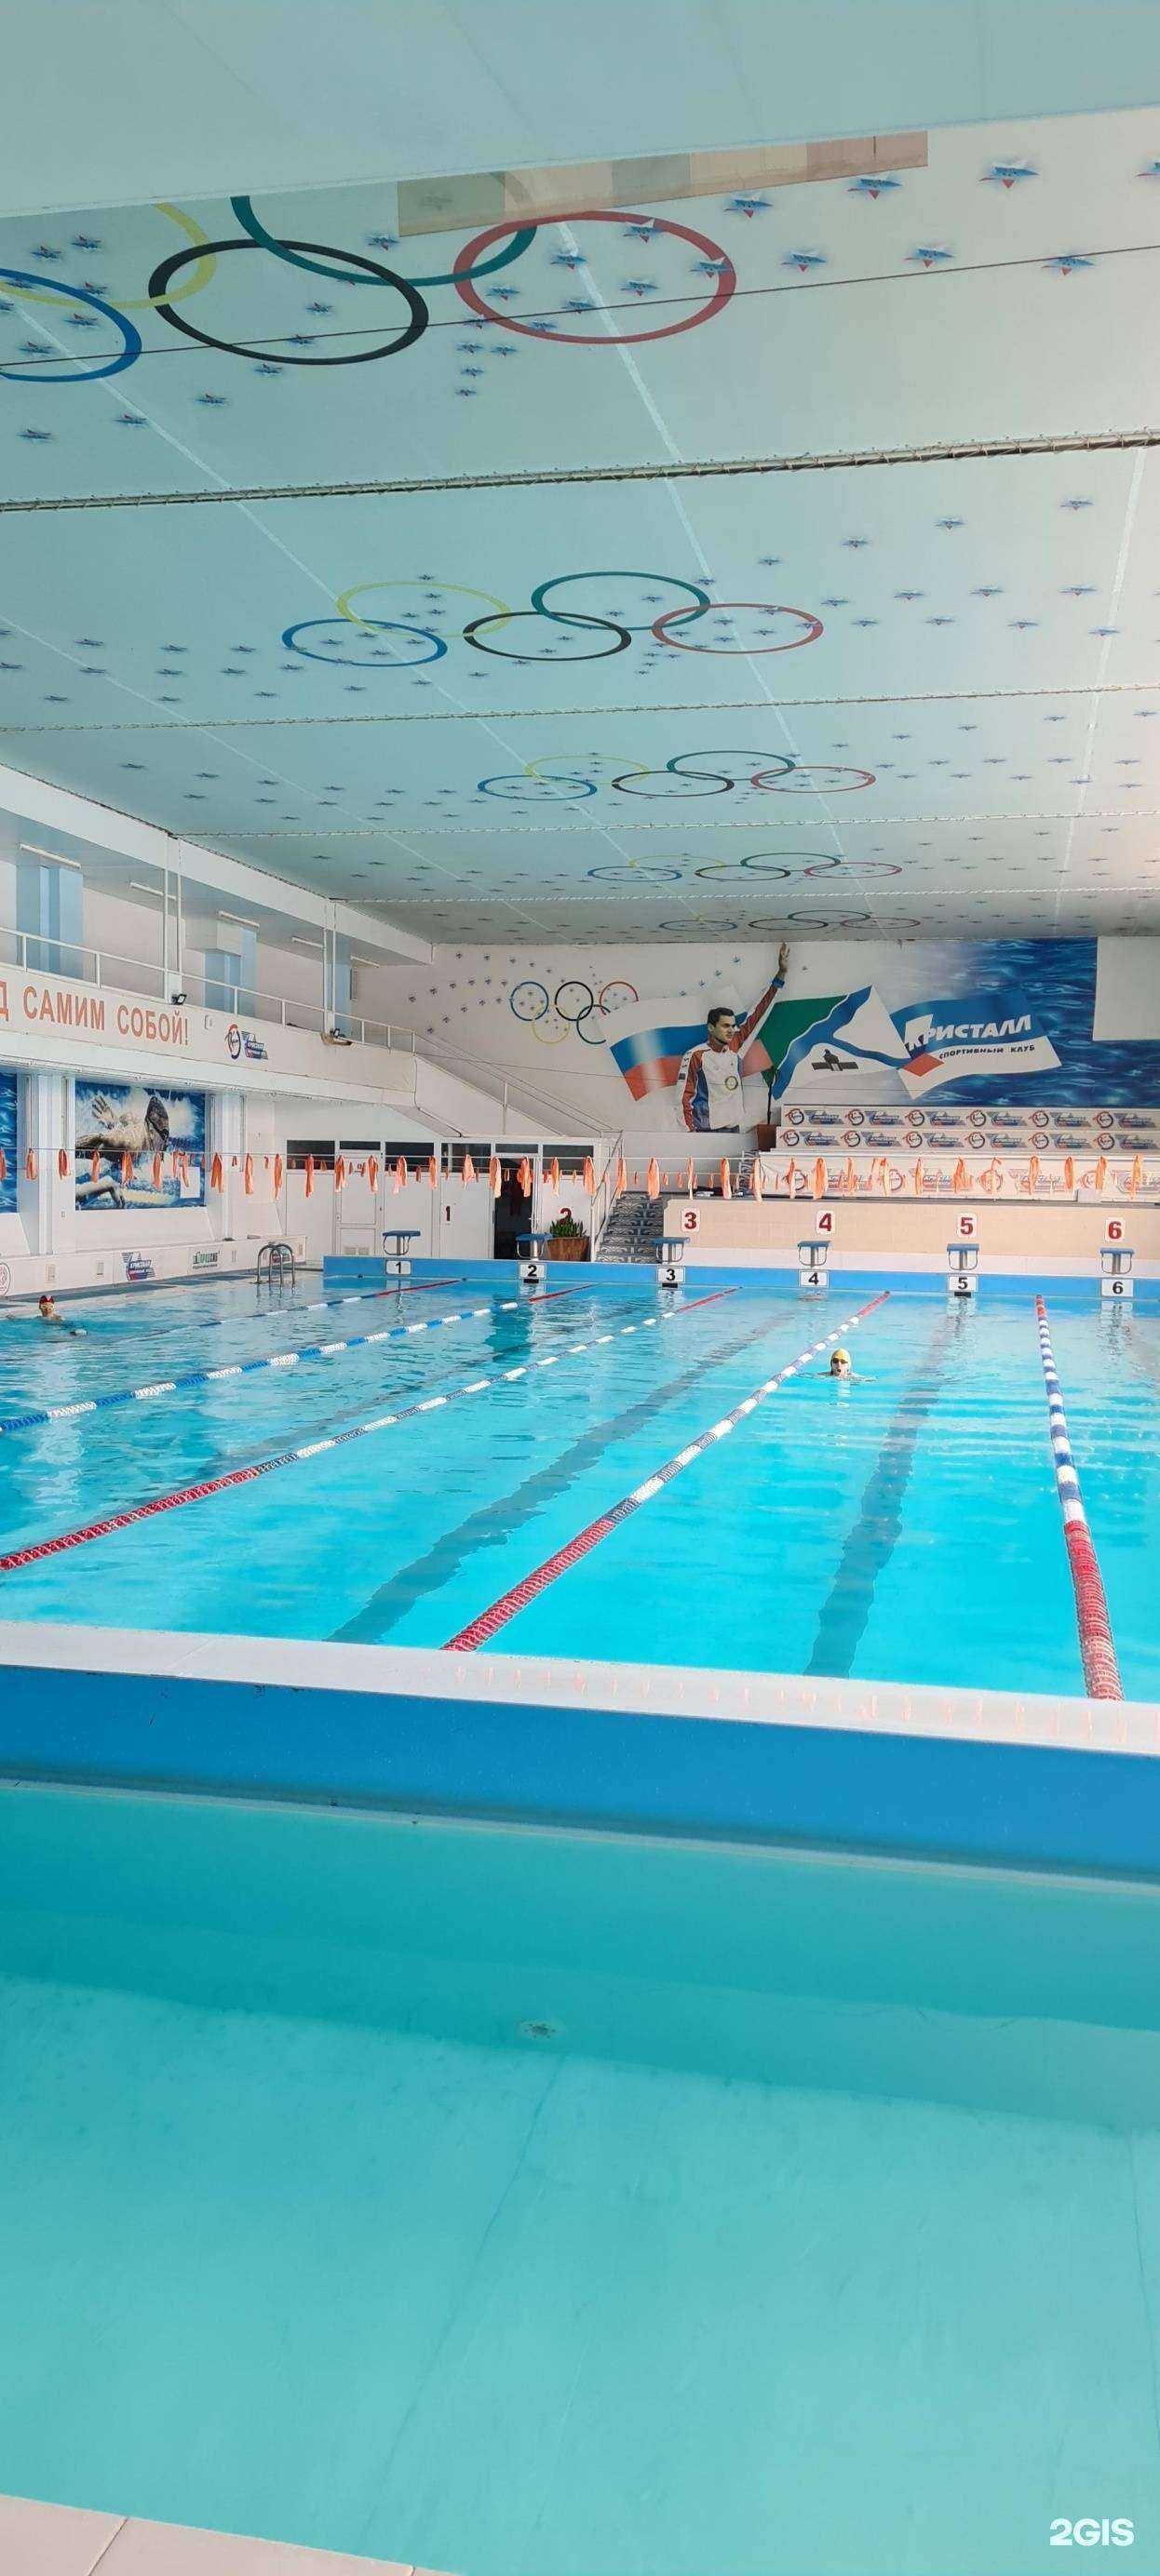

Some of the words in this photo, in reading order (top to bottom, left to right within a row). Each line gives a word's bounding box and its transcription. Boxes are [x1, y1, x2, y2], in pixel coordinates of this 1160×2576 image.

[22, 985, 106, 1031] САМИМ
[116, 1004, 189, 1046] СОБОЙ!
[904, 1013, 1032, 1052] КРИСТАЛЛ
[1010, 1044, 1035, 1053] КЛУБ
[446, 1206, 451, 1222] 1
[684, 1213, 697, 1229] 3
[818, 1213, 831, 1232] 4
[960, 1217, 974, 1235] 5
[1108, 1221, 1123, 1239] 6
[395, 1262, 402, 1274] 1
[527, 1265, 537, 1277] 2
[666, 1268, 676, 1281] 3
[808, 1272, 819, 1285] 4
[958, 1277, 968, 1290] 5
[1113, 1281, 1124, 1295] 6
